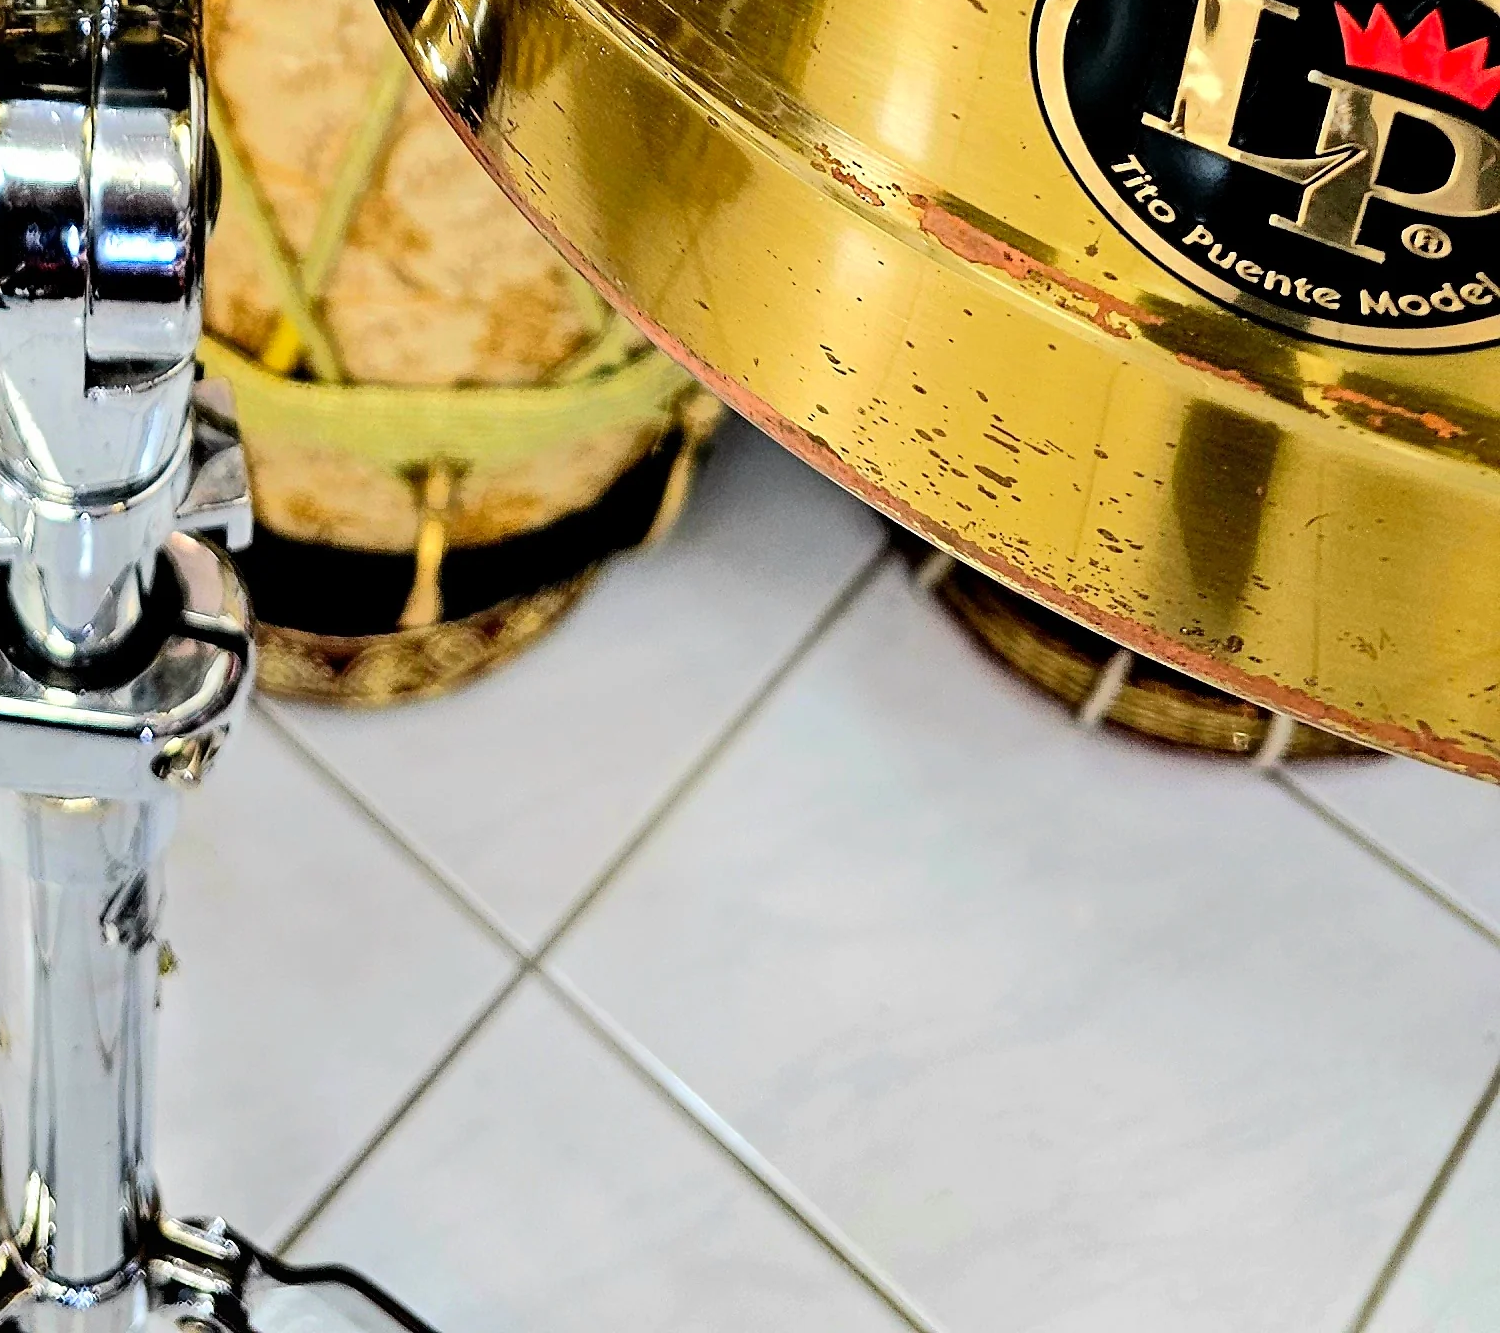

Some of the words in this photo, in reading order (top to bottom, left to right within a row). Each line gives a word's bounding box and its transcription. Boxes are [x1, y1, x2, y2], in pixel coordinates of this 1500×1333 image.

[1110, 154, 1177, 223] Tito
[1181, 224, 1342, 310] Puente
[1360, 271, 1500, 318] Model
